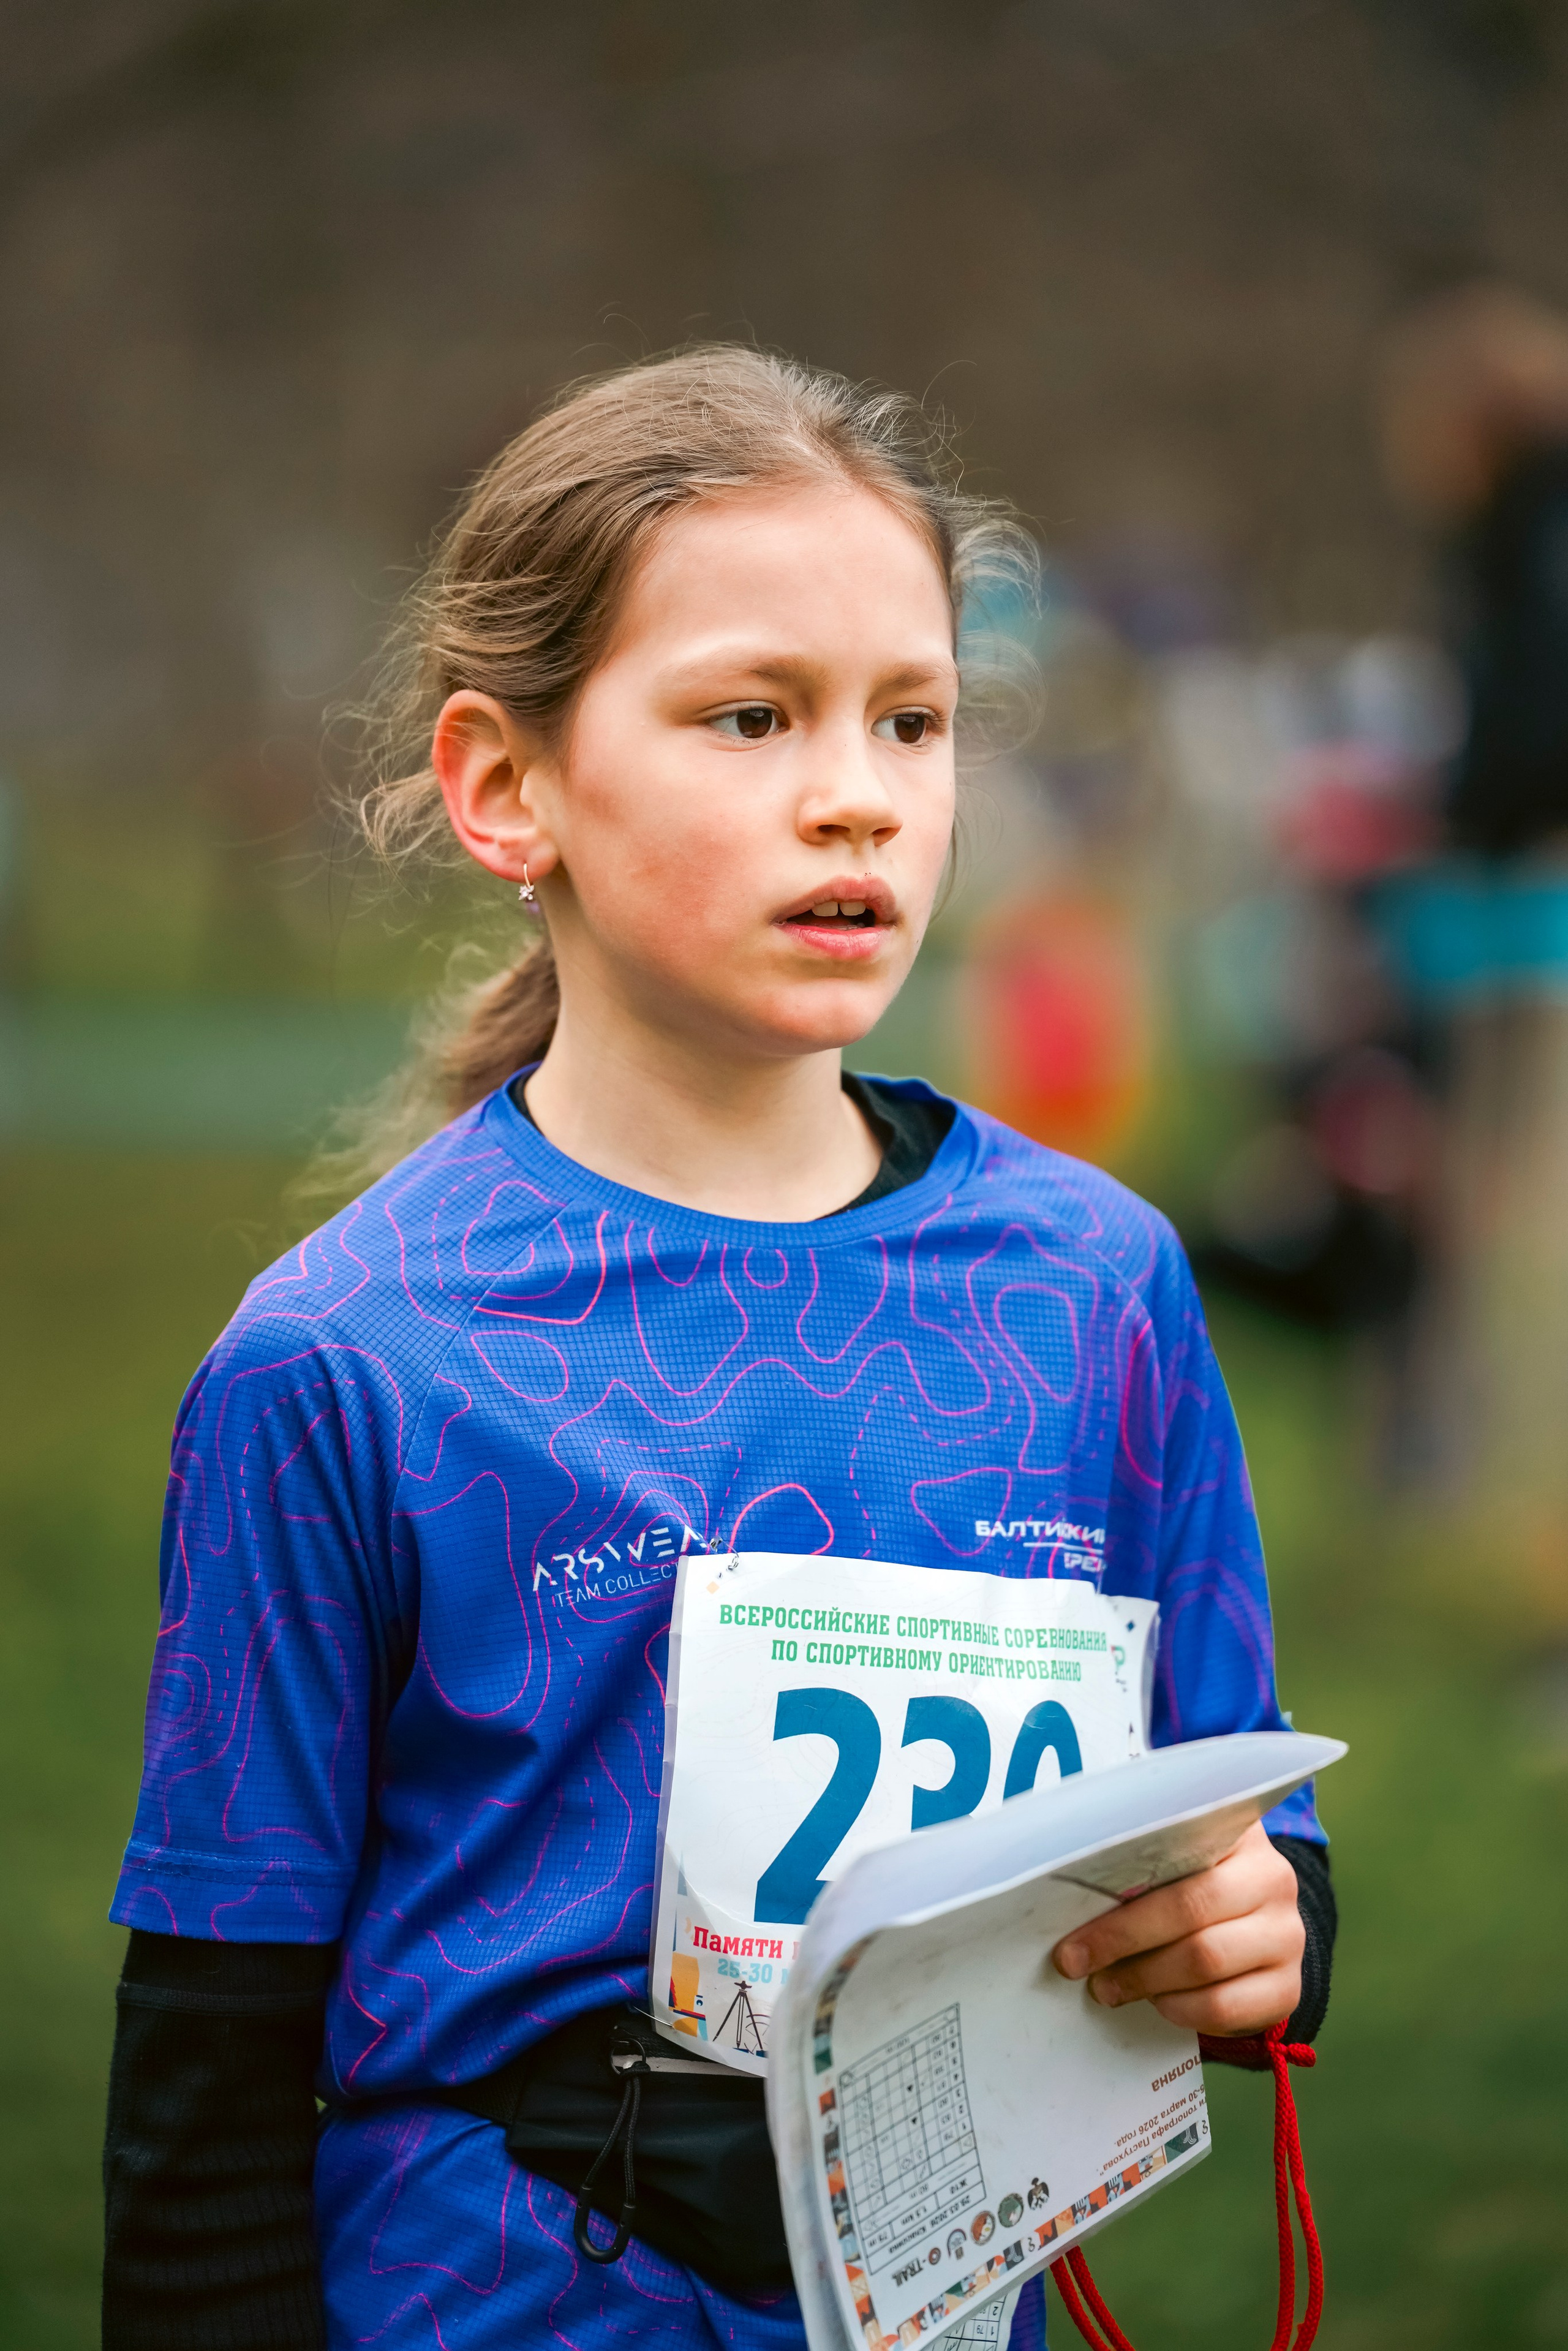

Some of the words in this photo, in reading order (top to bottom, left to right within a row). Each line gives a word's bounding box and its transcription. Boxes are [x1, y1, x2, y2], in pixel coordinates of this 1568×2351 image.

[555, 1582, 601, 1607] TEAM
[605, 1562, 679, 1594] COLLEC
[720, 1604, 890, 1635] ВСЕРОССИЙСКИЕ
[897, 1615, 1000, 1647] СПОРТИВНЫЕ
[1004, 1627, 1107, 1651] СОРЕВНОВАНИЯ
[771, 1639, 797, 1661] ПО
[806, 1642, 942, 1672] СПОРТИВНОМУ
[949, 1652, 1082, 1682] ОРИЕНТИРОВАНИЮ
[693, 1926, 783, 1959] Памяти
[717, 1958, 774, 1984] 25-30
[1152, 2101, 1198, 2140] топографа
[1161, 2097, 1186, 2119] марта
[1138, 2115, 1159, 2135] 2026
[992, 2306, 999, 2315] 2
[990, 2326, 995, 2336] 1
